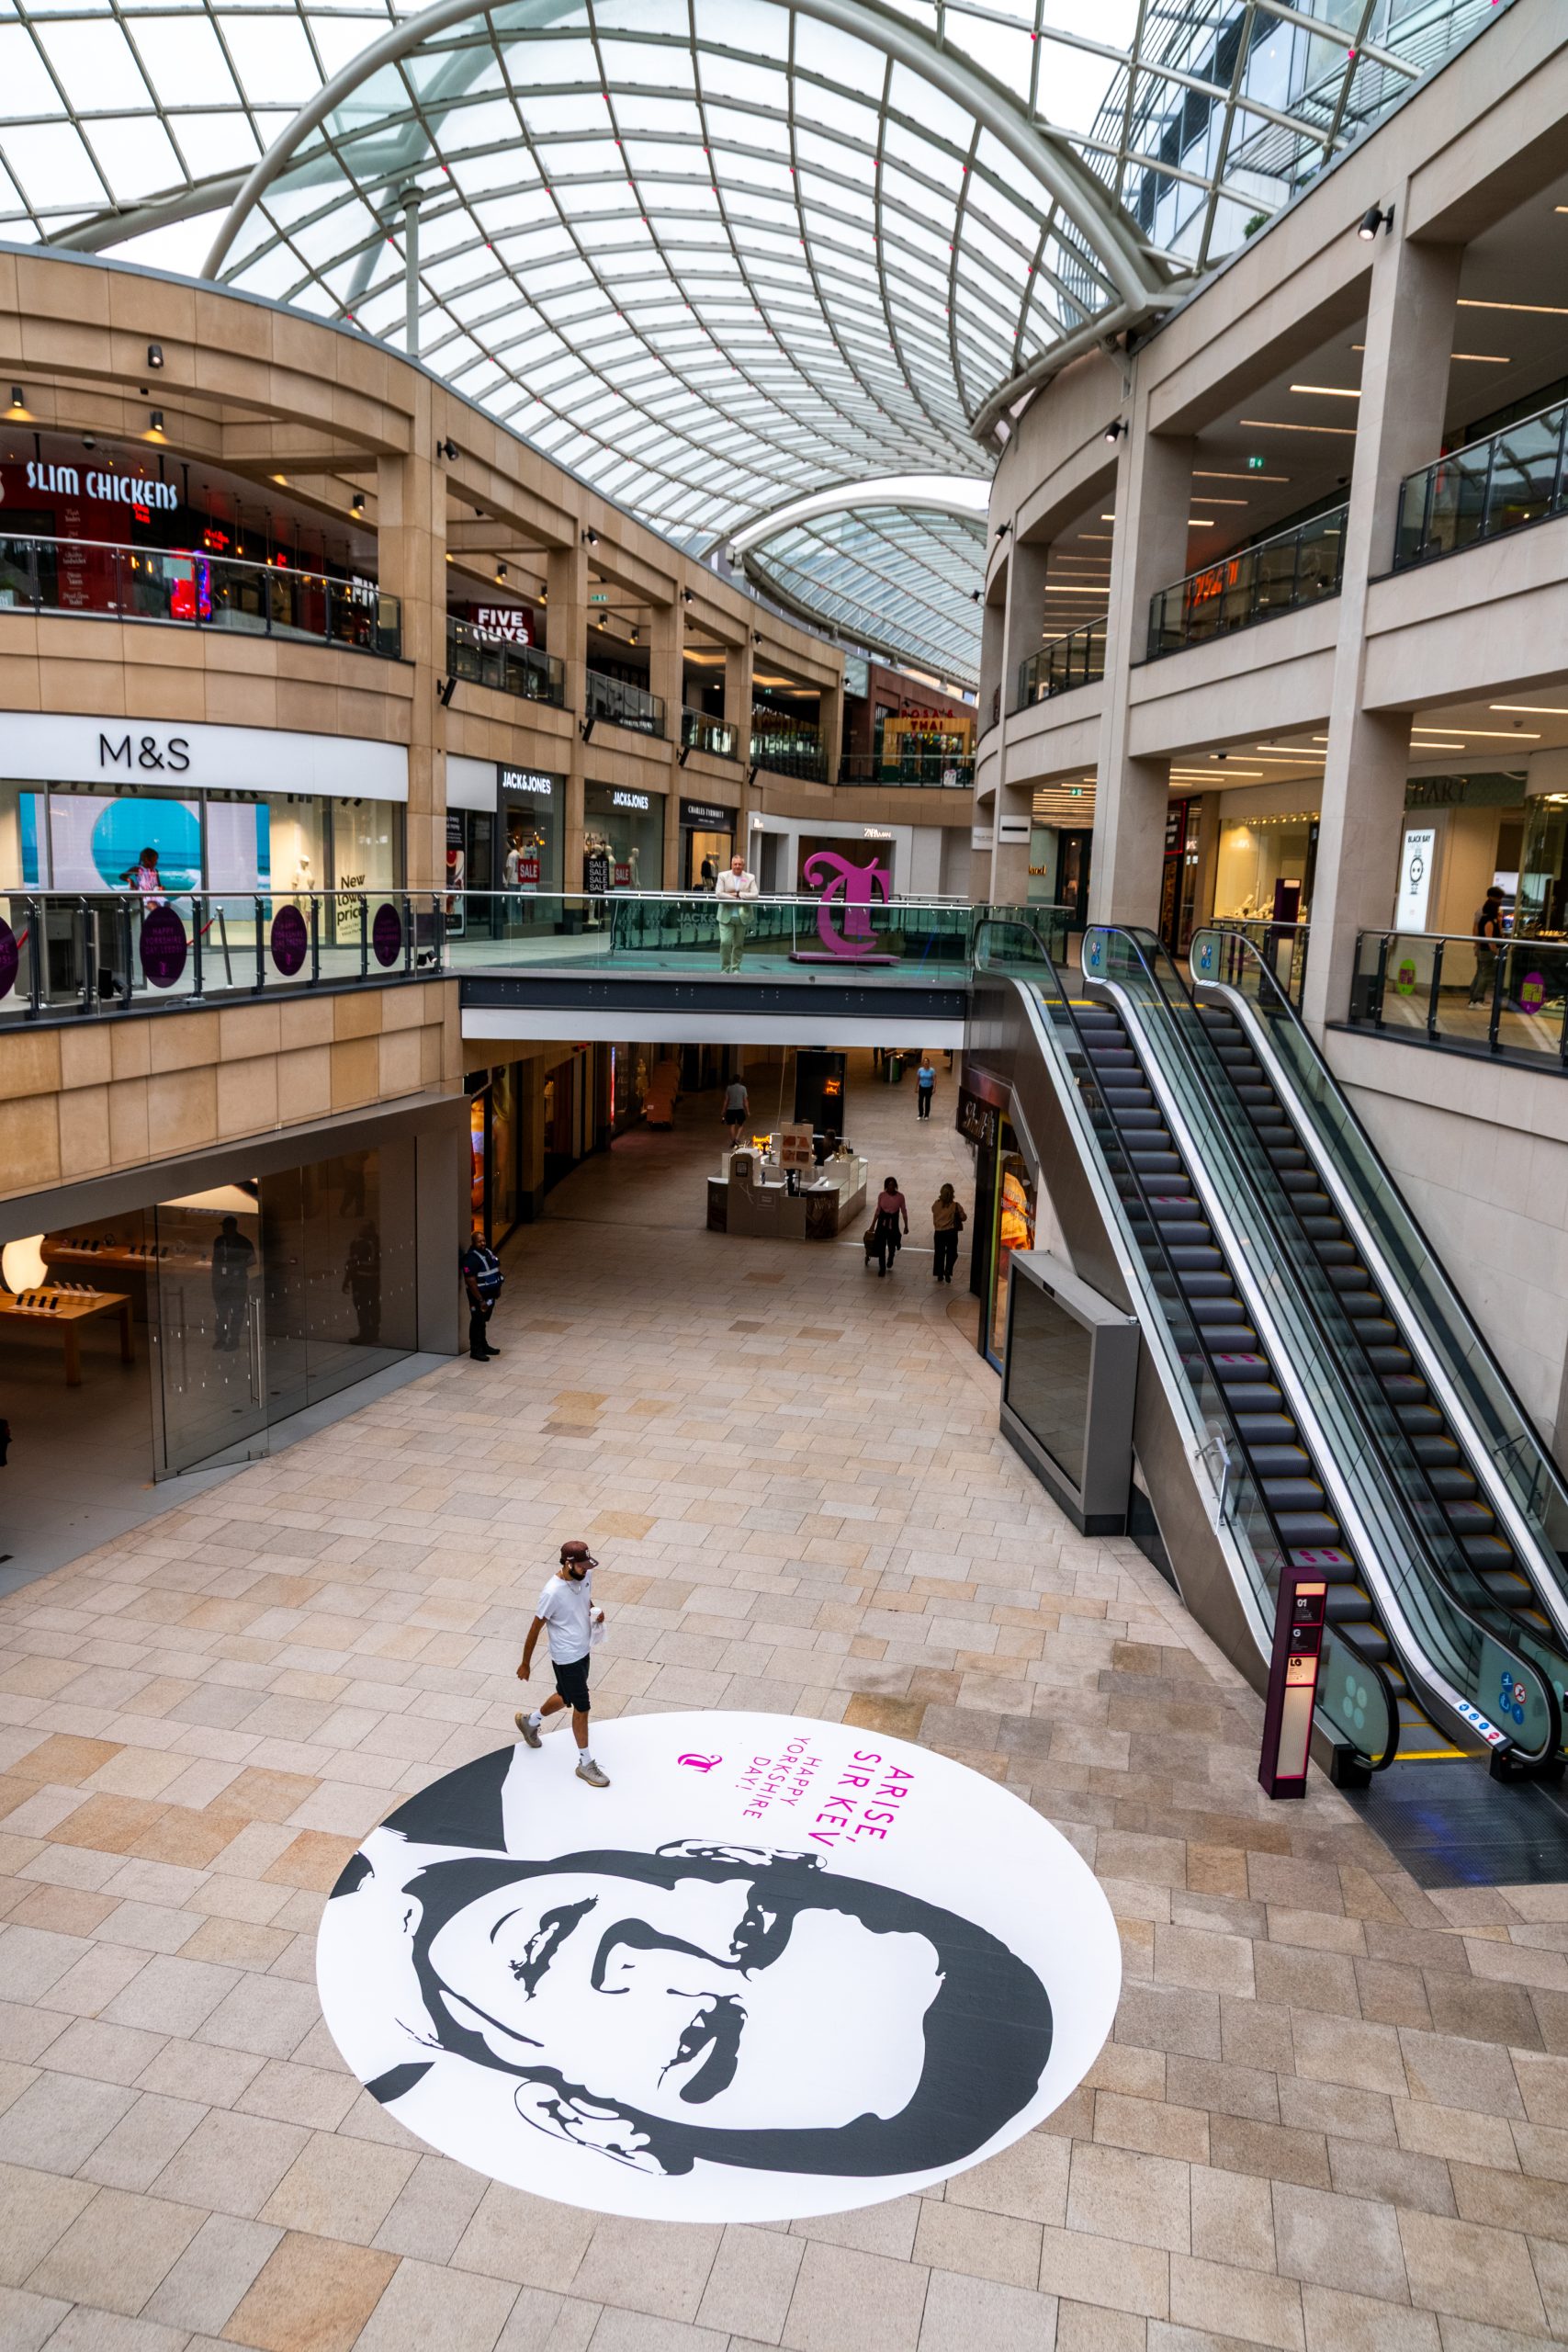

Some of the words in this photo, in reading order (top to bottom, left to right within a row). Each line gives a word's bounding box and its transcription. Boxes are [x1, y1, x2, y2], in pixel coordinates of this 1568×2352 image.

[26, 460, 80, 496] SLIM
[85, 470, 178, 511] CHICKENS
[478, 608, 524, 627] FIVE
[910, 720, 943, 730] THAI
[99, 733, 190, 771] M&S
[1407, 834, 1421, 842] BLACK
[1422, 834, 1431, 842] BAY
[520, 864, 538, 879] SALE
[589, 860, 608, 868] SALE
[589, 868, 608, 876] SALE
[615, 867, 629, 881] SALE
[341, 874, 366, 890] New
[589, 876, 608, 884] SALE
[1297, 1599, 1307, 1608] 01
[1292, 1628, 1302, 1637] G
[1290, 1658, 1303, 1667] LG
[735, 1757, 772, 1791] DAY!
[838, 1750, 882, 1788] SIR
[742, 1737, 811, 1819] YORKSHIRE
[780, 1757, 823, 1806] HAPPY
[807, 1796, 858, 1847] KEV
